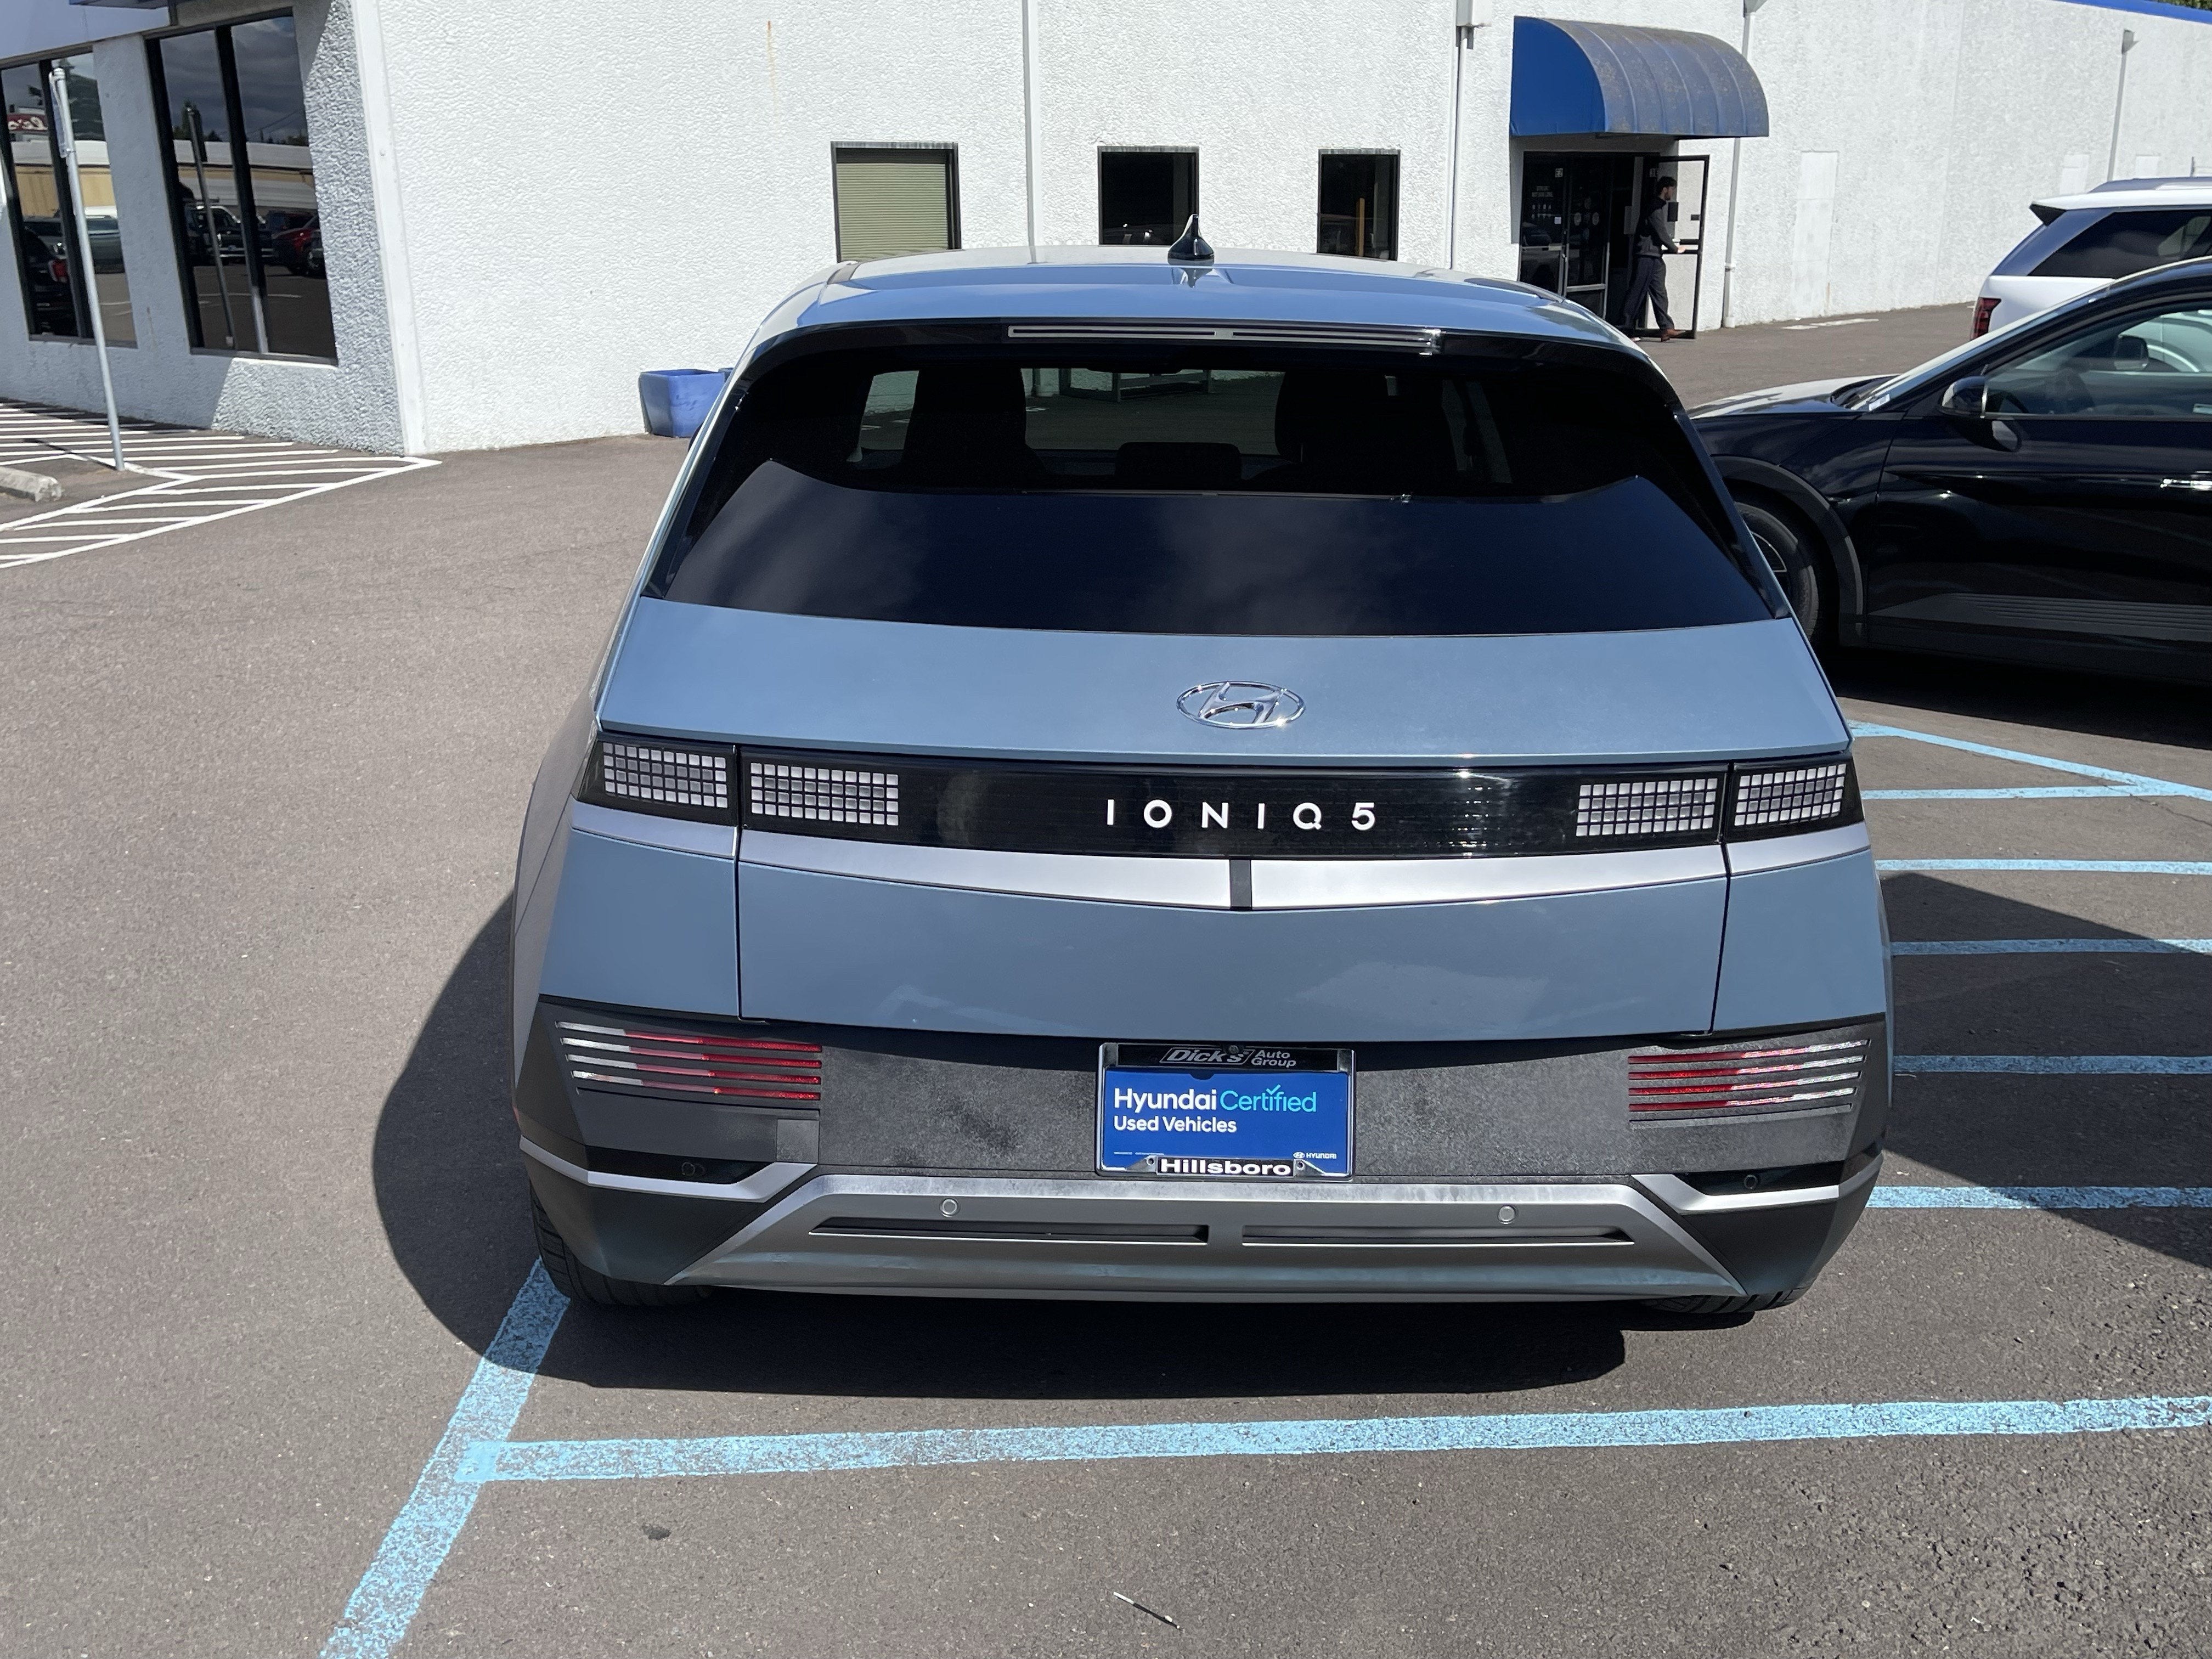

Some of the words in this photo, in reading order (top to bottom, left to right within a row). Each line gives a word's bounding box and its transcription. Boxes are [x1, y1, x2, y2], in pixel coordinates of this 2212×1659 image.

[1106, 799, 1322, 830] IONIQ
[1351, 802, 1376, 831] 5
[1166, 1049, 1244, 1063] Dicks
[1251, 1057, 1296, 1068] Group
[1255, 1049, 1290, 1059] Auto
[1114, 1088, 1217, 1113] Hyundai
[1220, 1085, 1317, 1113] Certified
[1114, 1115, 1159, 1132] Used
[1162, 1115, 1237, 1133] Vehicles
[1160, 1158, 1291, 1176] Hillsboro
